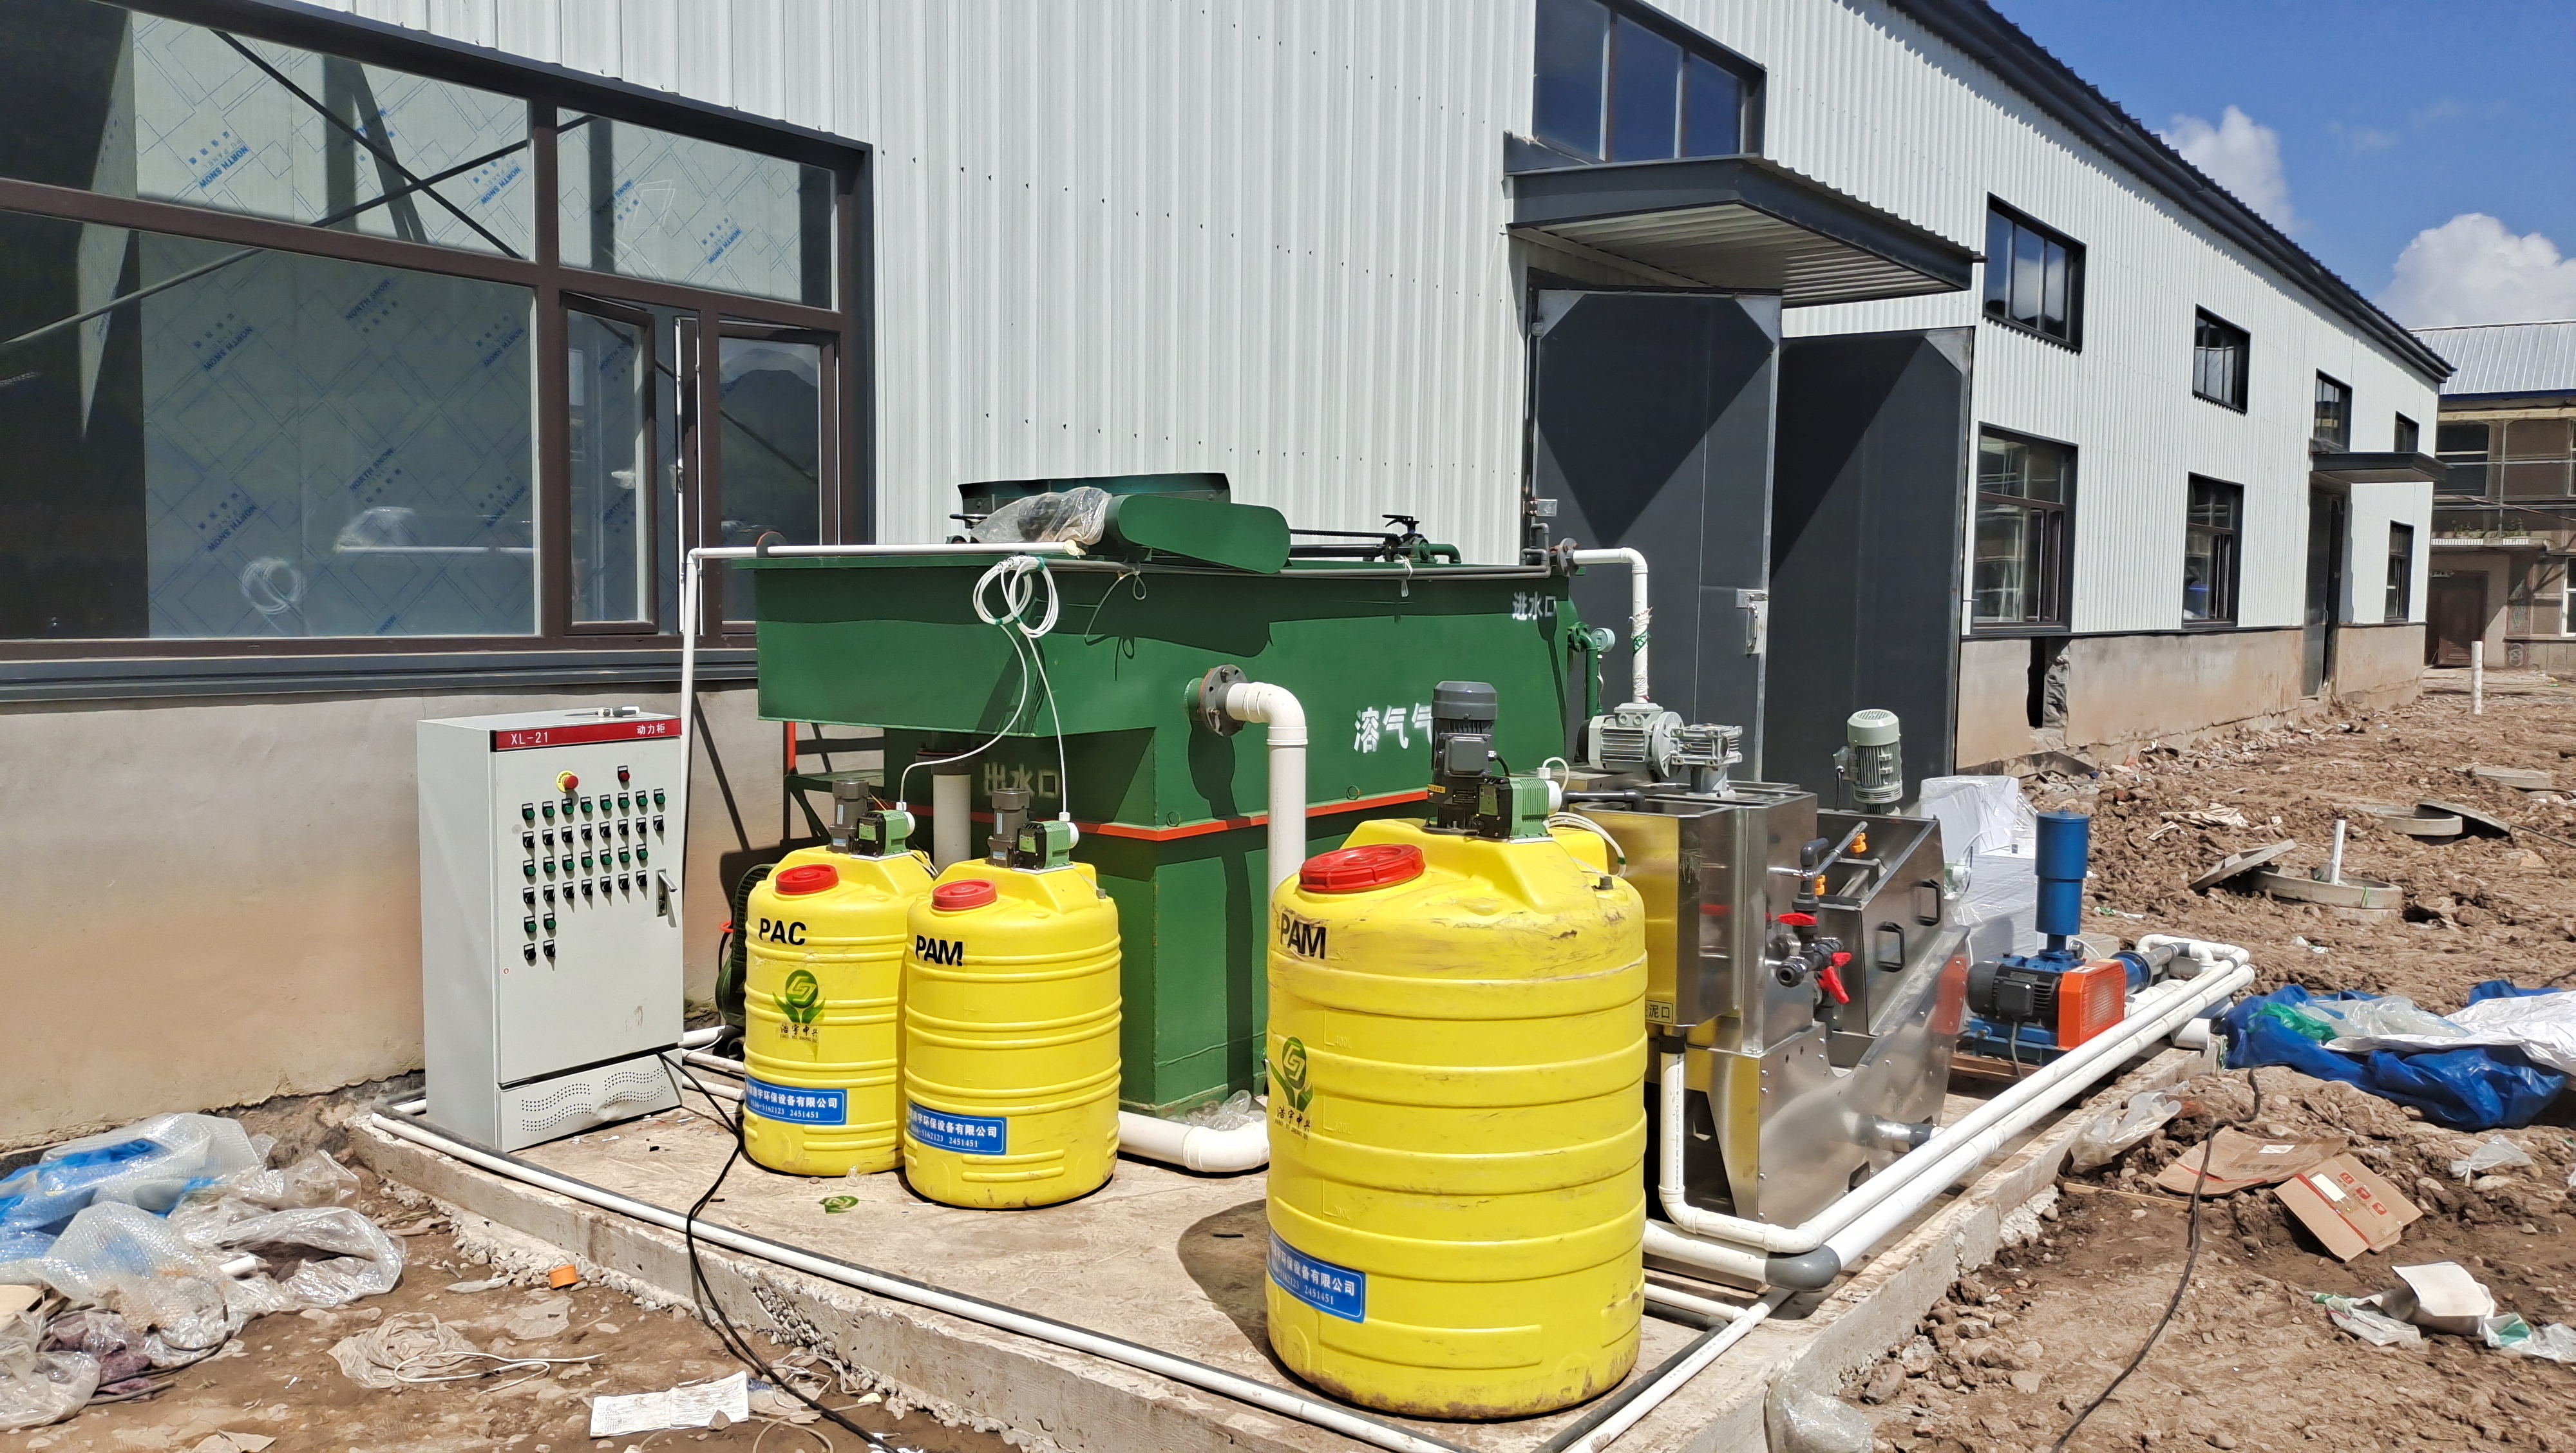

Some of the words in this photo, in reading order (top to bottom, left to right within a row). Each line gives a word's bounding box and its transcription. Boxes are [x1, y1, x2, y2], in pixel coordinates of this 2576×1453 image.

[221, 145, 249, 171] NORTH
[198, 167, 223, 189] SNOW
[498, 166, 521, 188] NORTH
[480, 185, 500, 205] SNOW
[614, 180, 633, 198] SNOW
[723, 228, 742, 249] NORTH
[708, 246, 724, 265] SNOW
[346, 297, 372, 321] NORTH
[369, 280, 390, 301] SNOW
[225, 325, 254, 352] NORTH
[502, 327, 525, 349] NORTH
[203, 349, 227, 372] SNOW
[483, 347, 504, 367] SNOW
[349, 466, 374, 492] NORTH
[373, 447, 394, 470] SNOW
[504, 484, 527, 510] NORTH
[229, 504, 258, 531] NORTH
[207, 528, 232, 553] SNOW
[511, 731, 549, 746] XL-21
[636, 723, 666, 736] 动力柜
[983, 761, 1061, 799] 出水口
[758, 917, 807, 945] PAC
[1280, 911, 1327, 960] PAM
[915, 935, 963, 967] PAM
[1645, 1004, 1670, 1019] 泥口
[790, 1109, 819, 1119] 2451451
[949, 1137, 978, 1148] 2451451
[1304, 1285, 1334, 1305] 2451451
